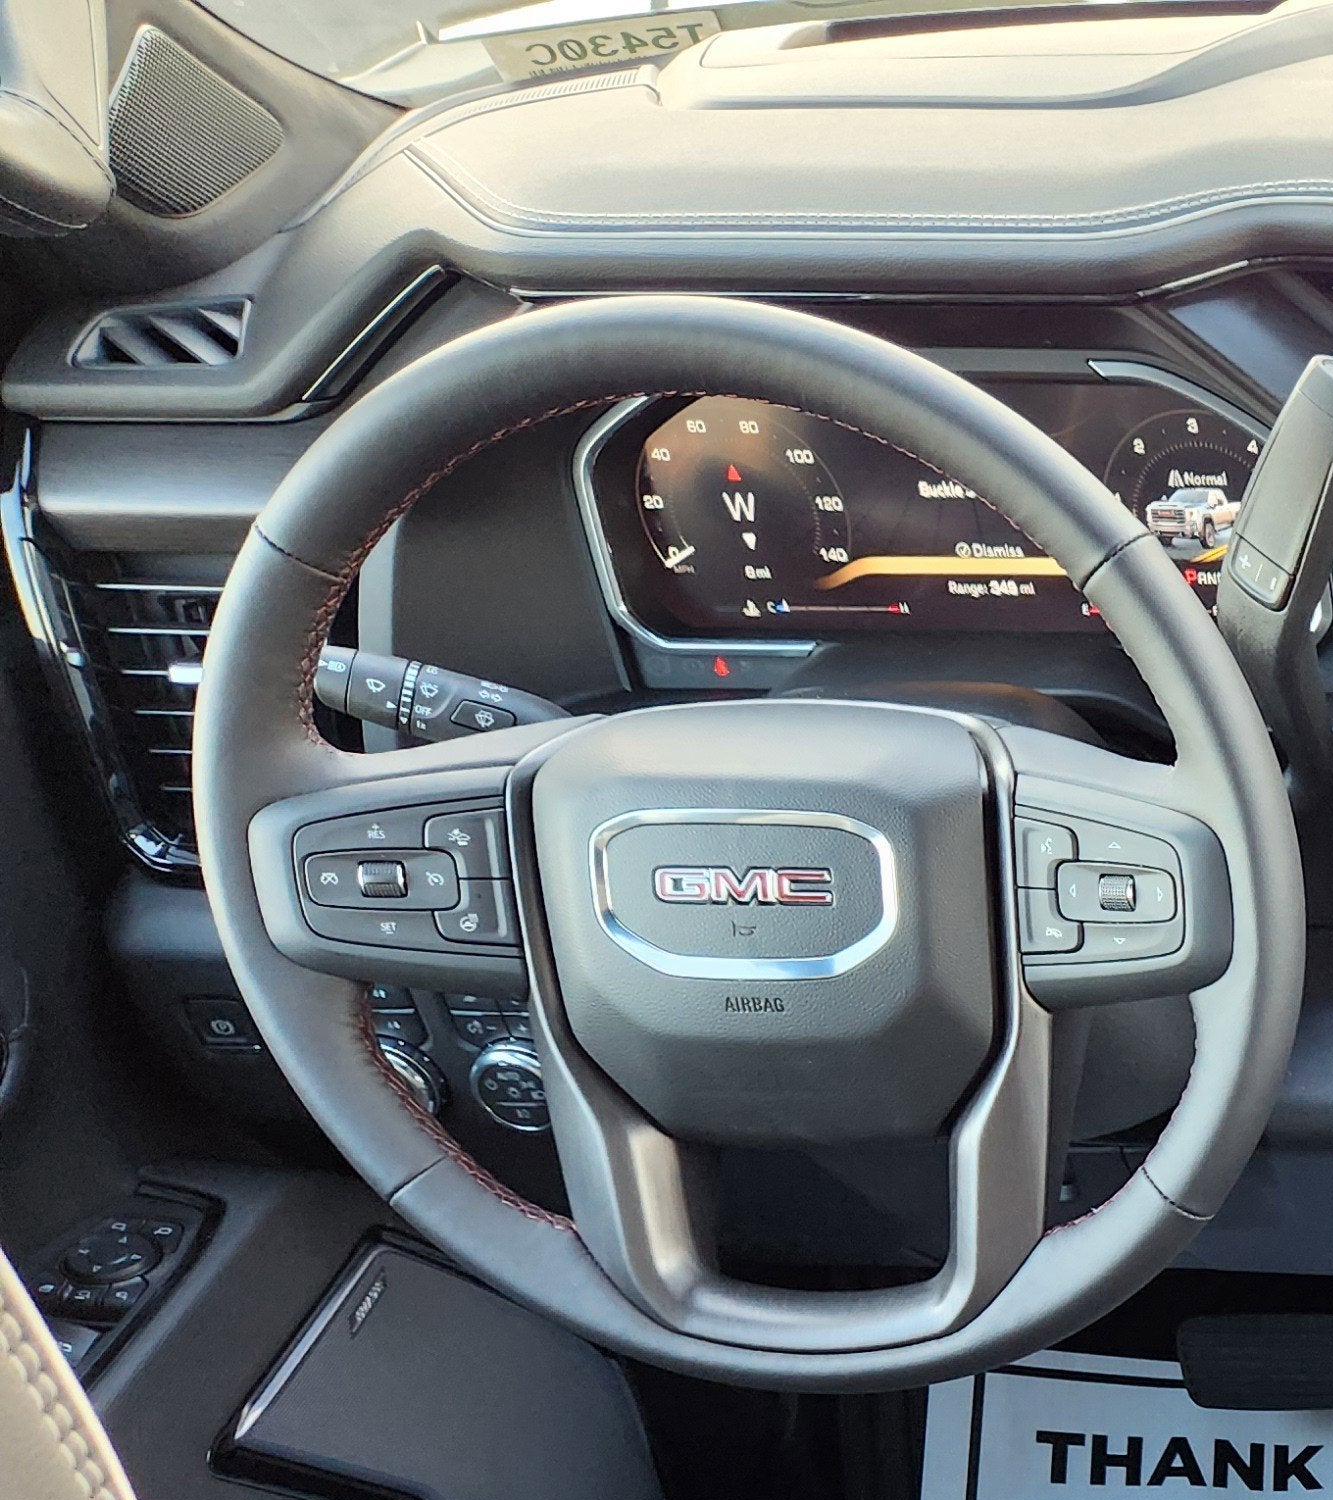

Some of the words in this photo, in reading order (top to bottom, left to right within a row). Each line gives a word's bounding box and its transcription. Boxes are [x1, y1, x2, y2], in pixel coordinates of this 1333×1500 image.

[686, 419, 707, 434] 60
[738, 419, 760, 435] 80
[650, 447, 671, 462] 40
[785, 448, 815, 465] 100
[1183, 470, 1228, 487] Normal
[642, 494, 664, 510] 20
[721, 491, 756, 523] W
[815, 496, 844, 513] 120
[819, 547, 850, 563] 140
[652, 865, 834, 906] GMC
[724, 996, 786, 1013] AIRBAG
[1036, 1429, 1323, 1492] THANK
